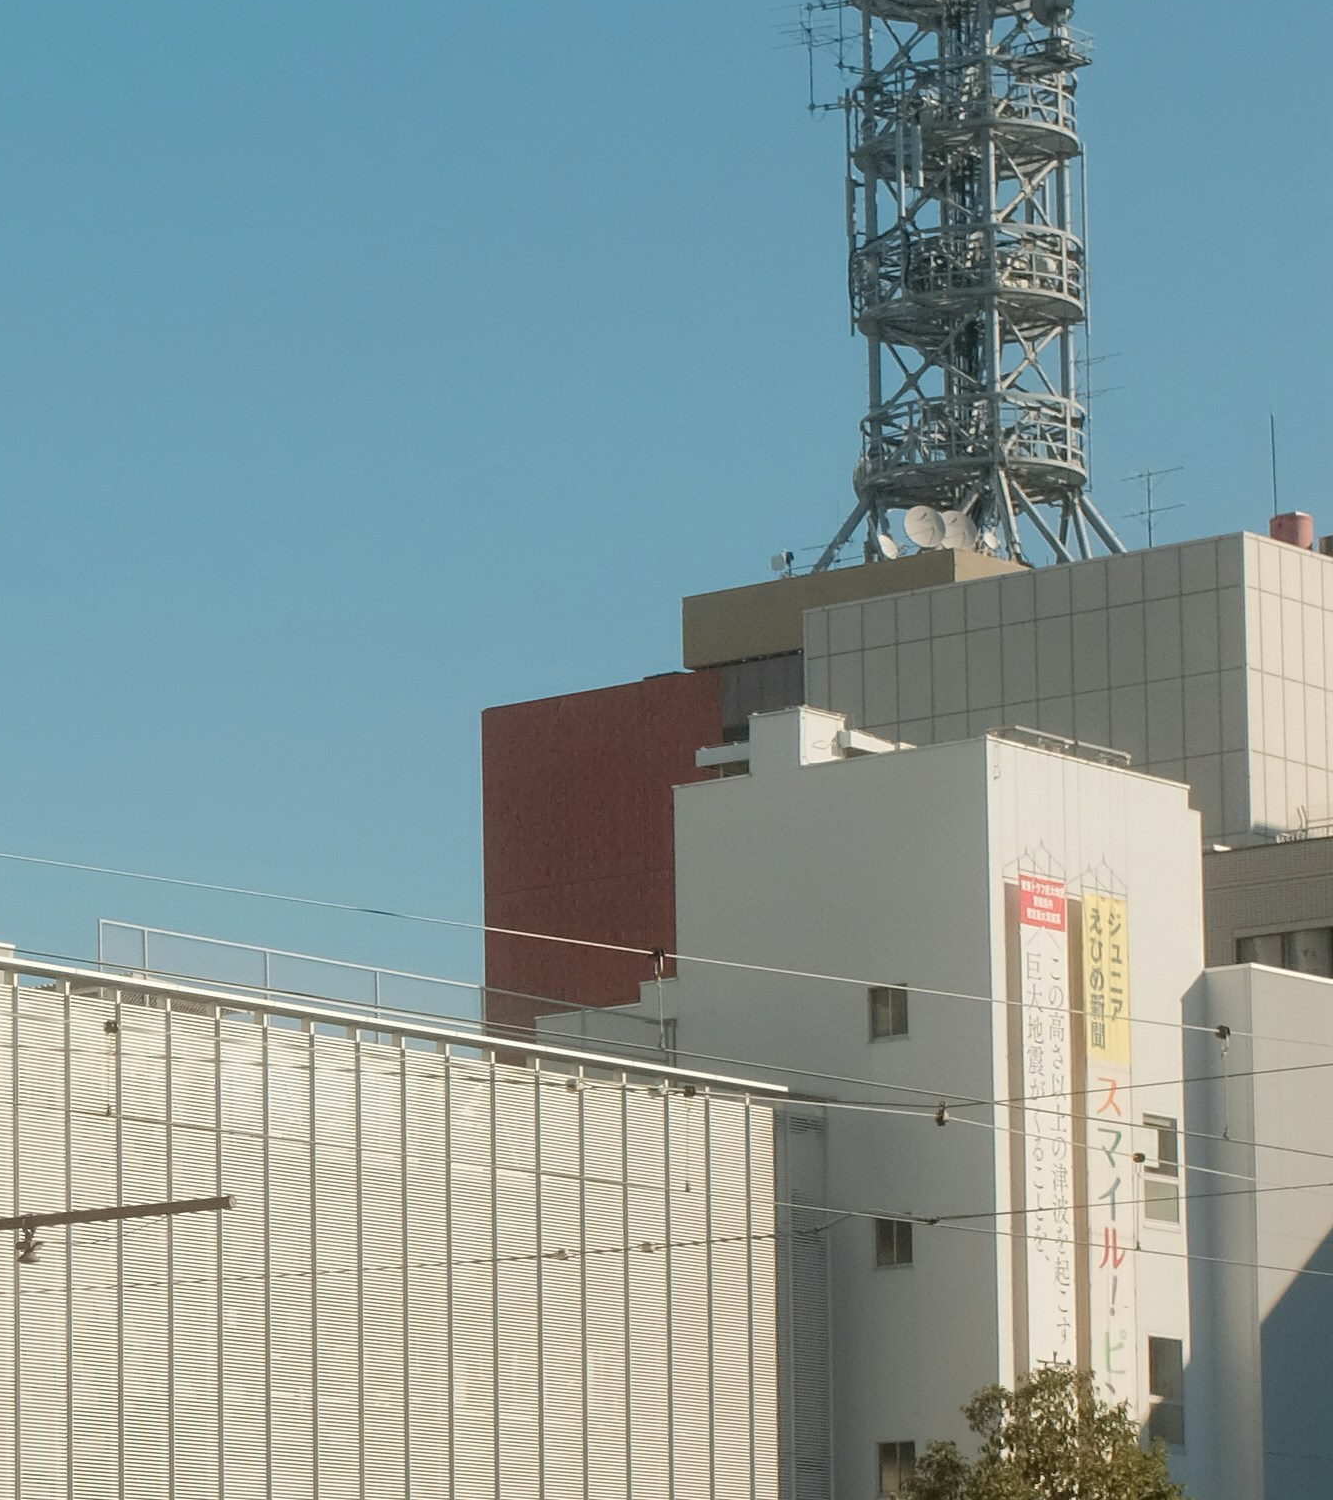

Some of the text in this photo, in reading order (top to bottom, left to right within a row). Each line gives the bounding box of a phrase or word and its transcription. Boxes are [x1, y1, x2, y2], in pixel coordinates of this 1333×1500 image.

[1089, 907, 1106, 1050] えひめ新聞
[1107, 912, 1124, 1023] ジュニア
